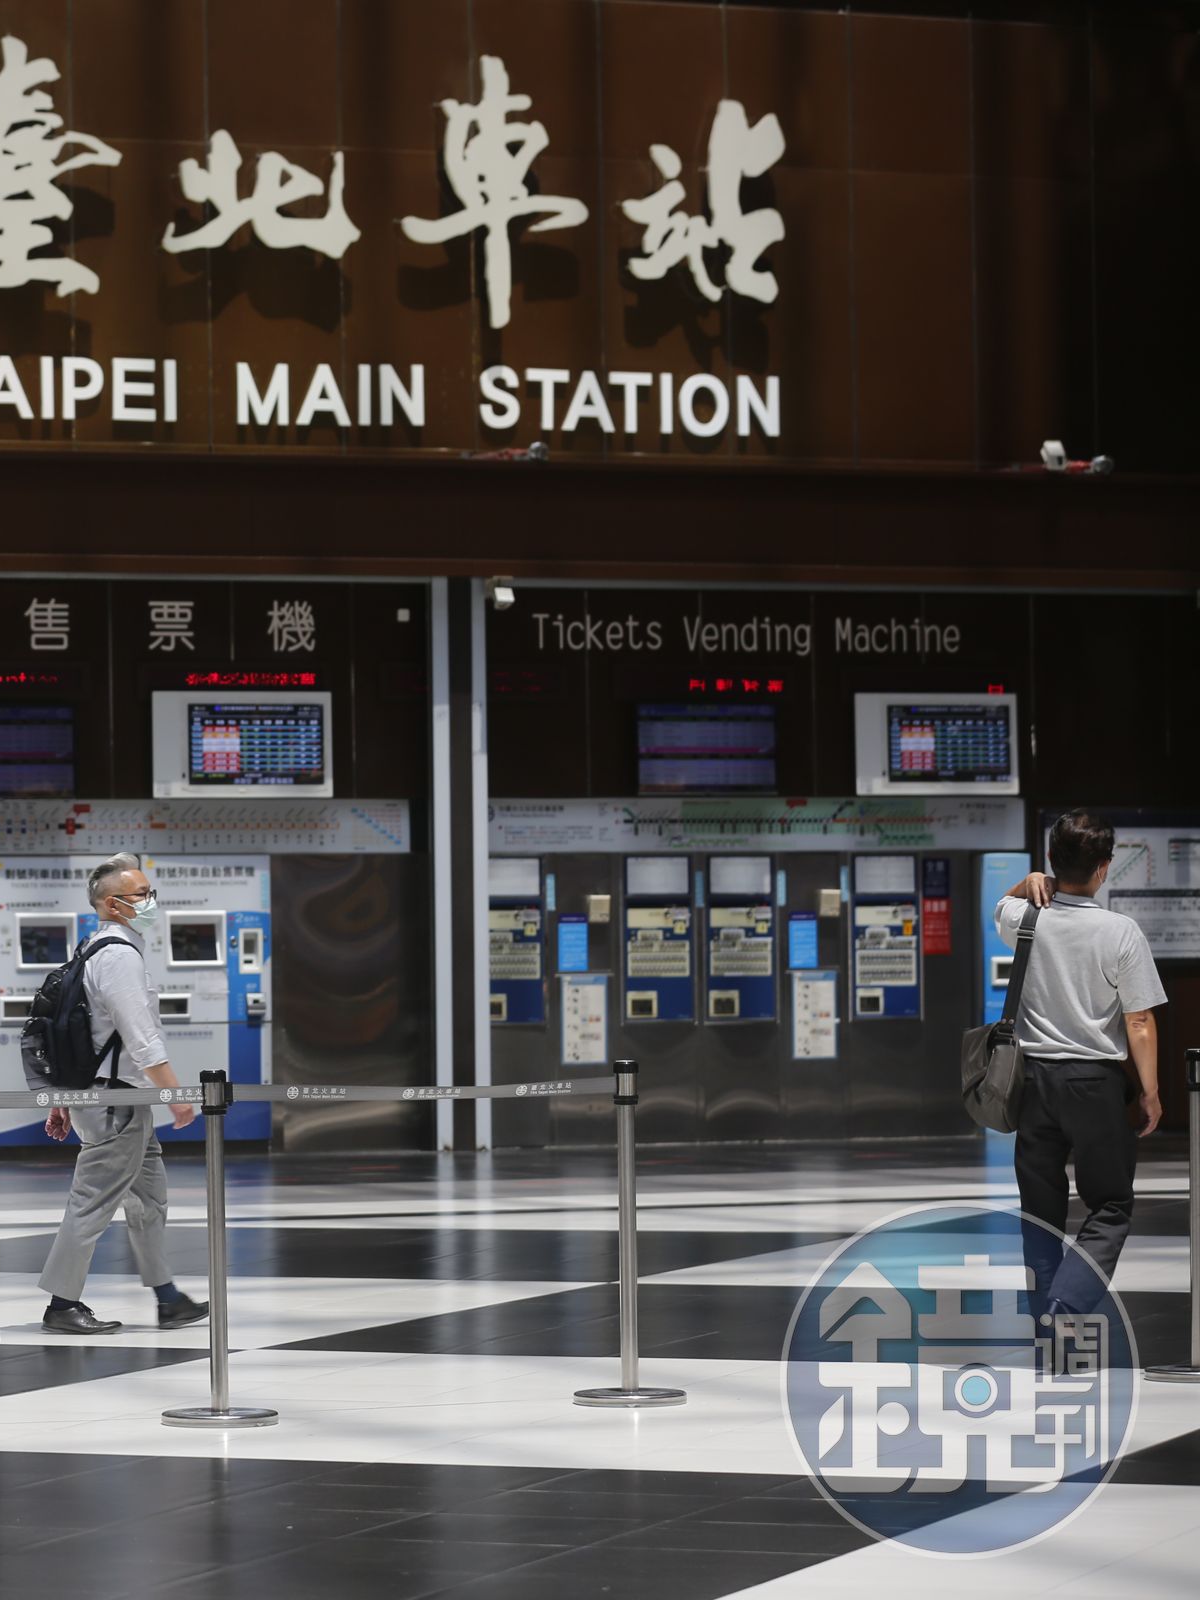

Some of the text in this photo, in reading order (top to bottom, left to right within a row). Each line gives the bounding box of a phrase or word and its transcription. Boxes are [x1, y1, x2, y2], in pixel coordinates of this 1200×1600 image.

[236, 361, 425, 427] MAIN
[479, 365, 780, 437] STATION
[532, 613, 961, 656] Tickets Vending Machine
[53, 1092, 99, 1100] 臺北火車站
